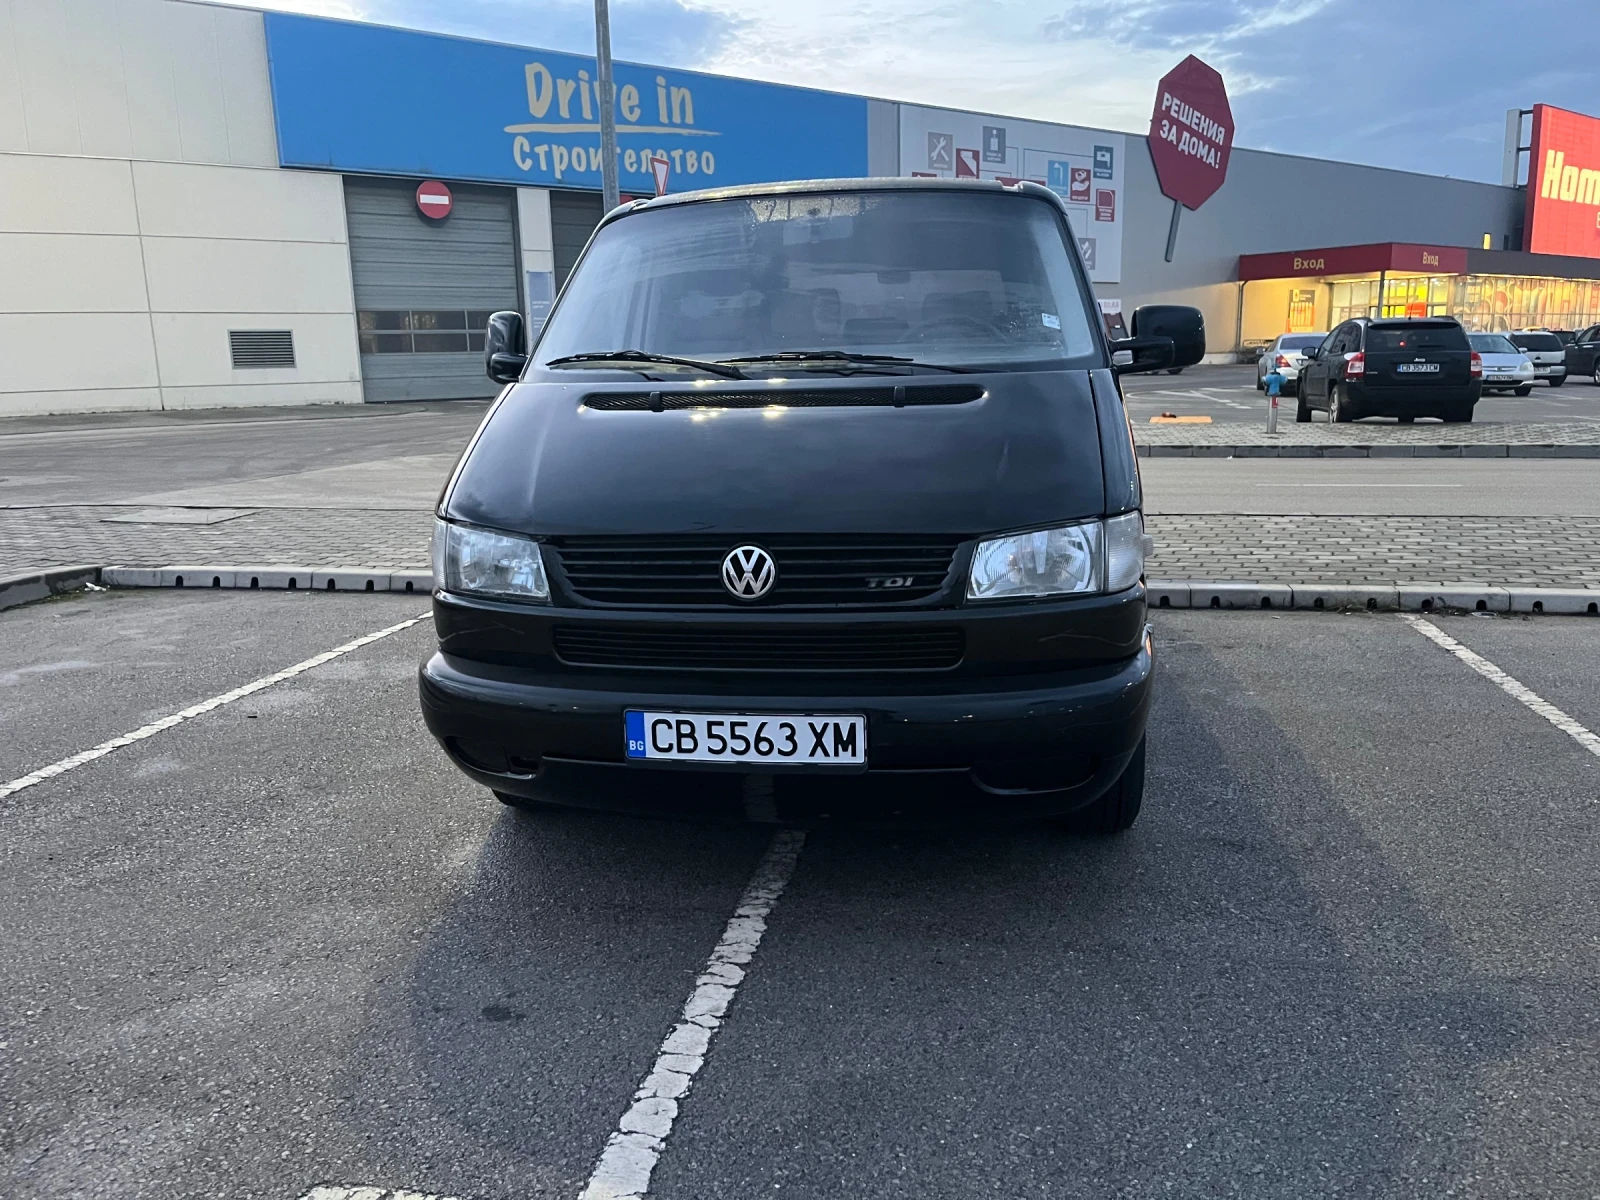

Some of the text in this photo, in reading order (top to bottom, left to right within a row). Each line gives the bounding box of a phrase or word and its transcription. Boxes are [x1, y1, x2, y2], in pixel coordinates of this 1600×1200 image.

[656, 75, 694, 125] in
[1162, 92, 1225, 146] РЕШЕНИЯ
[1160, 119, 1221, 169] ЗА ДОМА!
[1293, 257, 1325, 271] Вход
[1422, 251, 1439, 267] Вход
[866, 576, 915, 591] TDI
[629, 740, 644, 751] BG
[651, 718, 857, 758] CB 5563 XM
